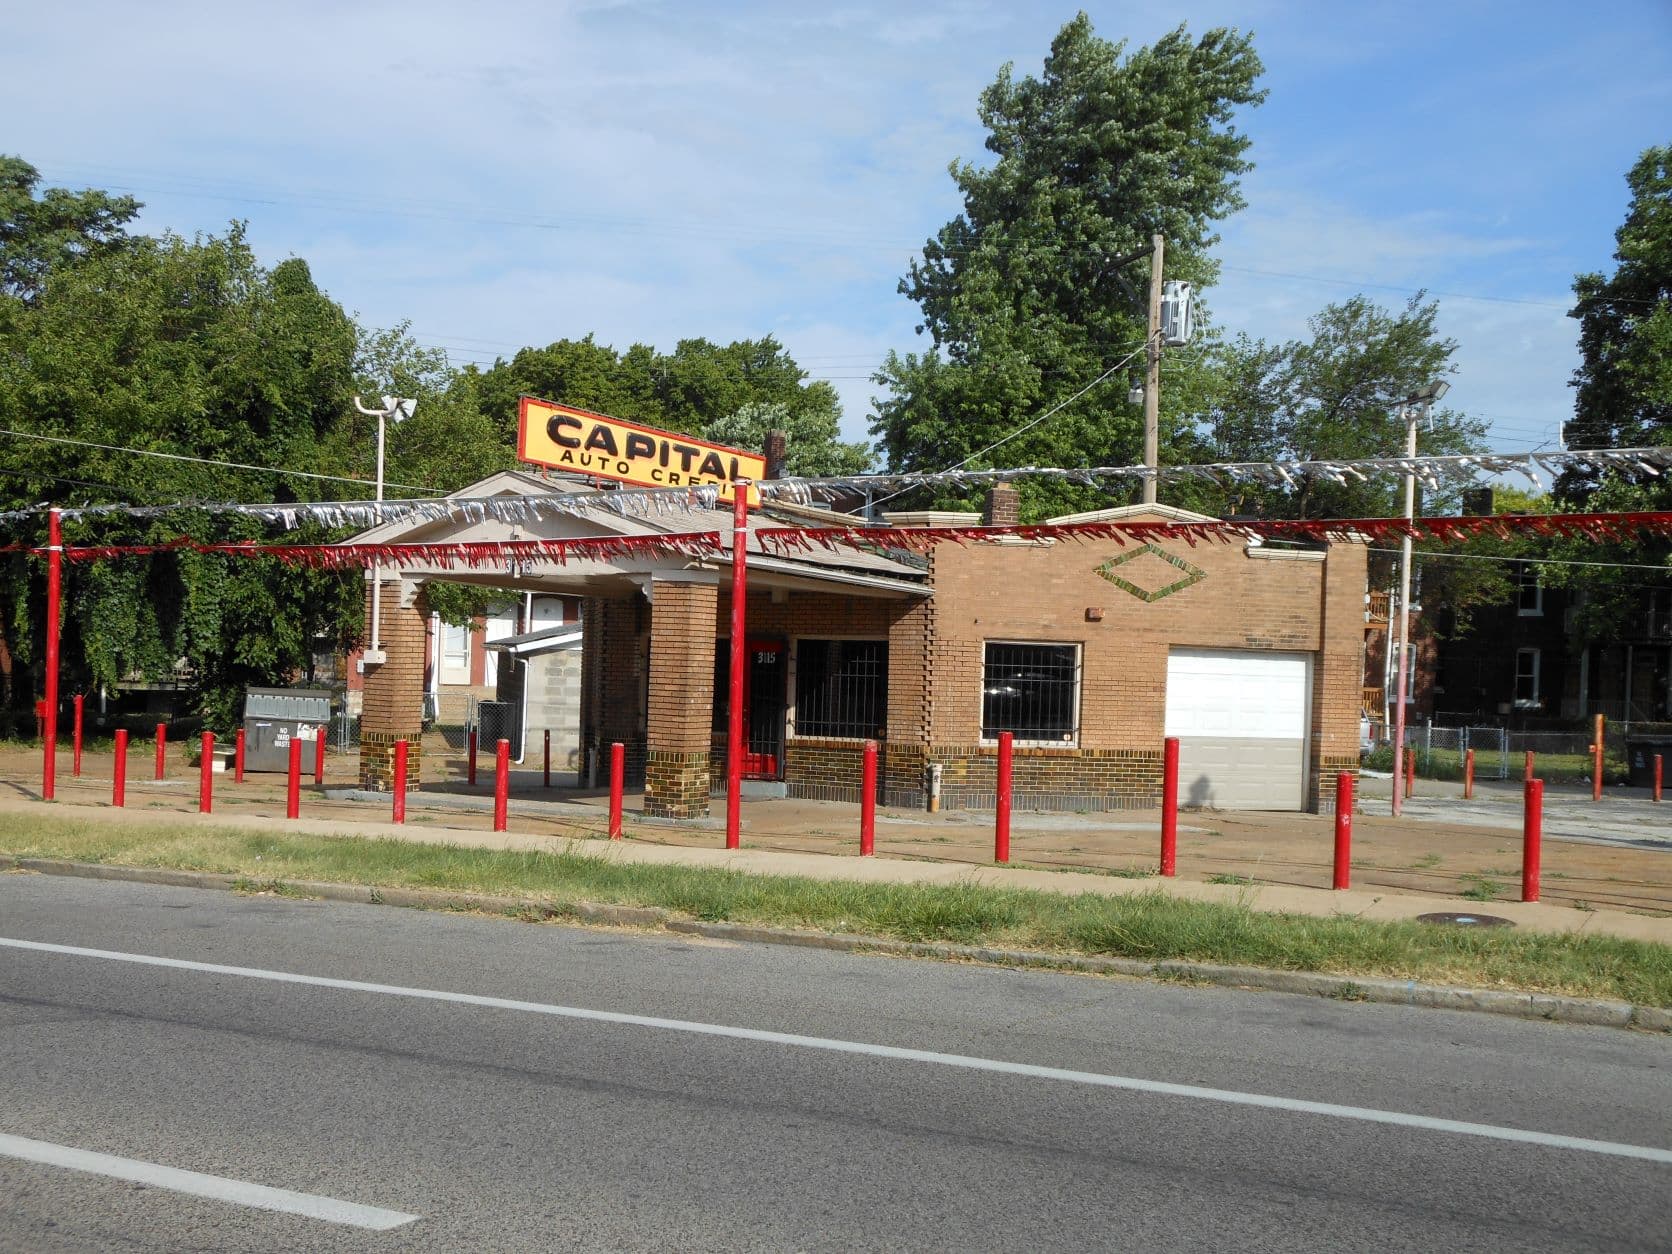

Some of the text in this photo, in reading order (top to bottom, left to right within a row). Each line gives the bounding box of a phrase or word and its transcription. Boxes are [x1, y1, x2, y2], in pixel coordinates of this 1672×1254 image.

[546, 414, 752, 484] CAPITAL
[560, 449, 736, 495] AUTO CREI
[506, 559, 532, 573] 315
